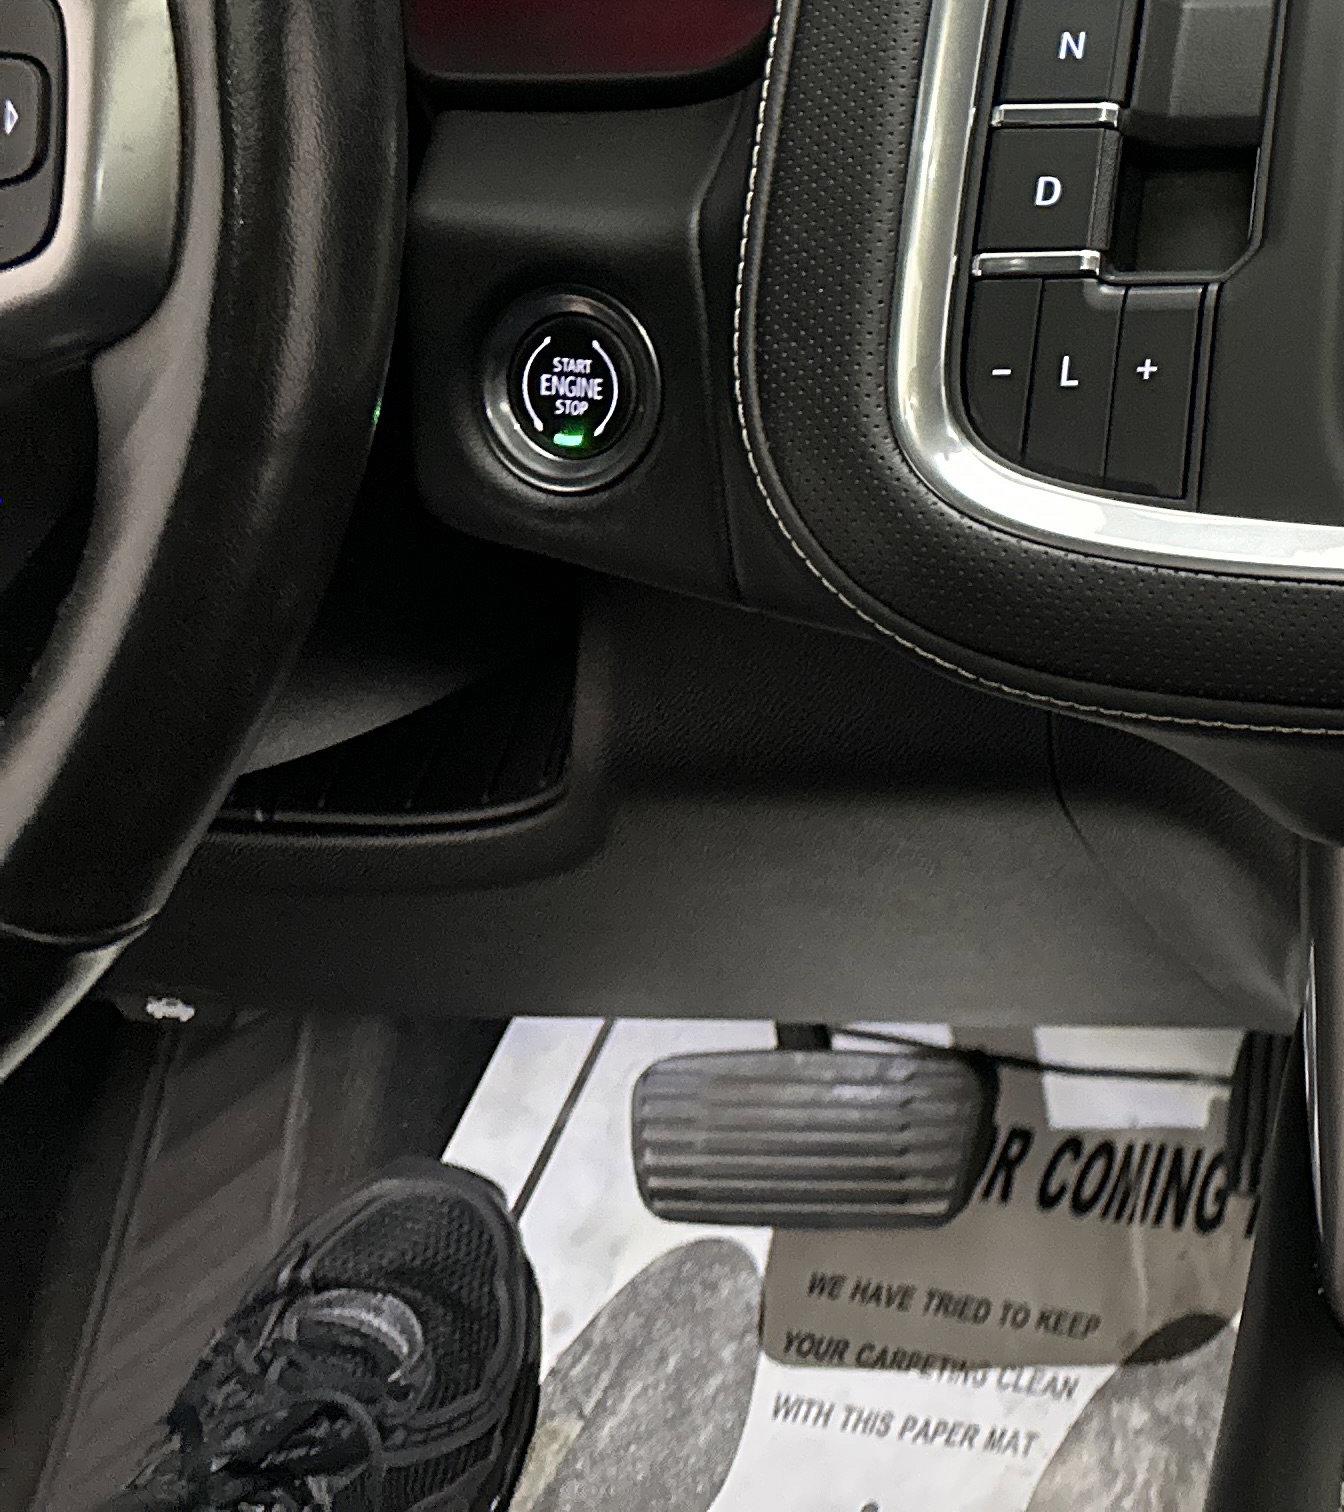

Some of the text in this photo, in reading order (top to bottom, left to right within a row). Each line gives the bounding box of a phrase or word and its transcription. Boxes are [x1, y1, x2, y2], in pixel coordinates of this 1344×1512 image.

[1058, 31, 1086, 60] N
[1034, 175, 1062, 206] D
[552, 356, 593, 374] START
[1060, 355, 1079, 387] L
[539, 373, 604, 401] ENGINE
[554, 399, 589, 416] STOP
[807, 1272, 847, 1301] WE
[850, 1276, 915, 1313] HAVE
[1000, 1299, 1030, 1330] TO
[1034, 1306, 1101, 1340] KEEP
[783, 1329, 848, 1362] YOUR
[771, 1392, 1040, 1458] WITH THIS PAPER MAT
